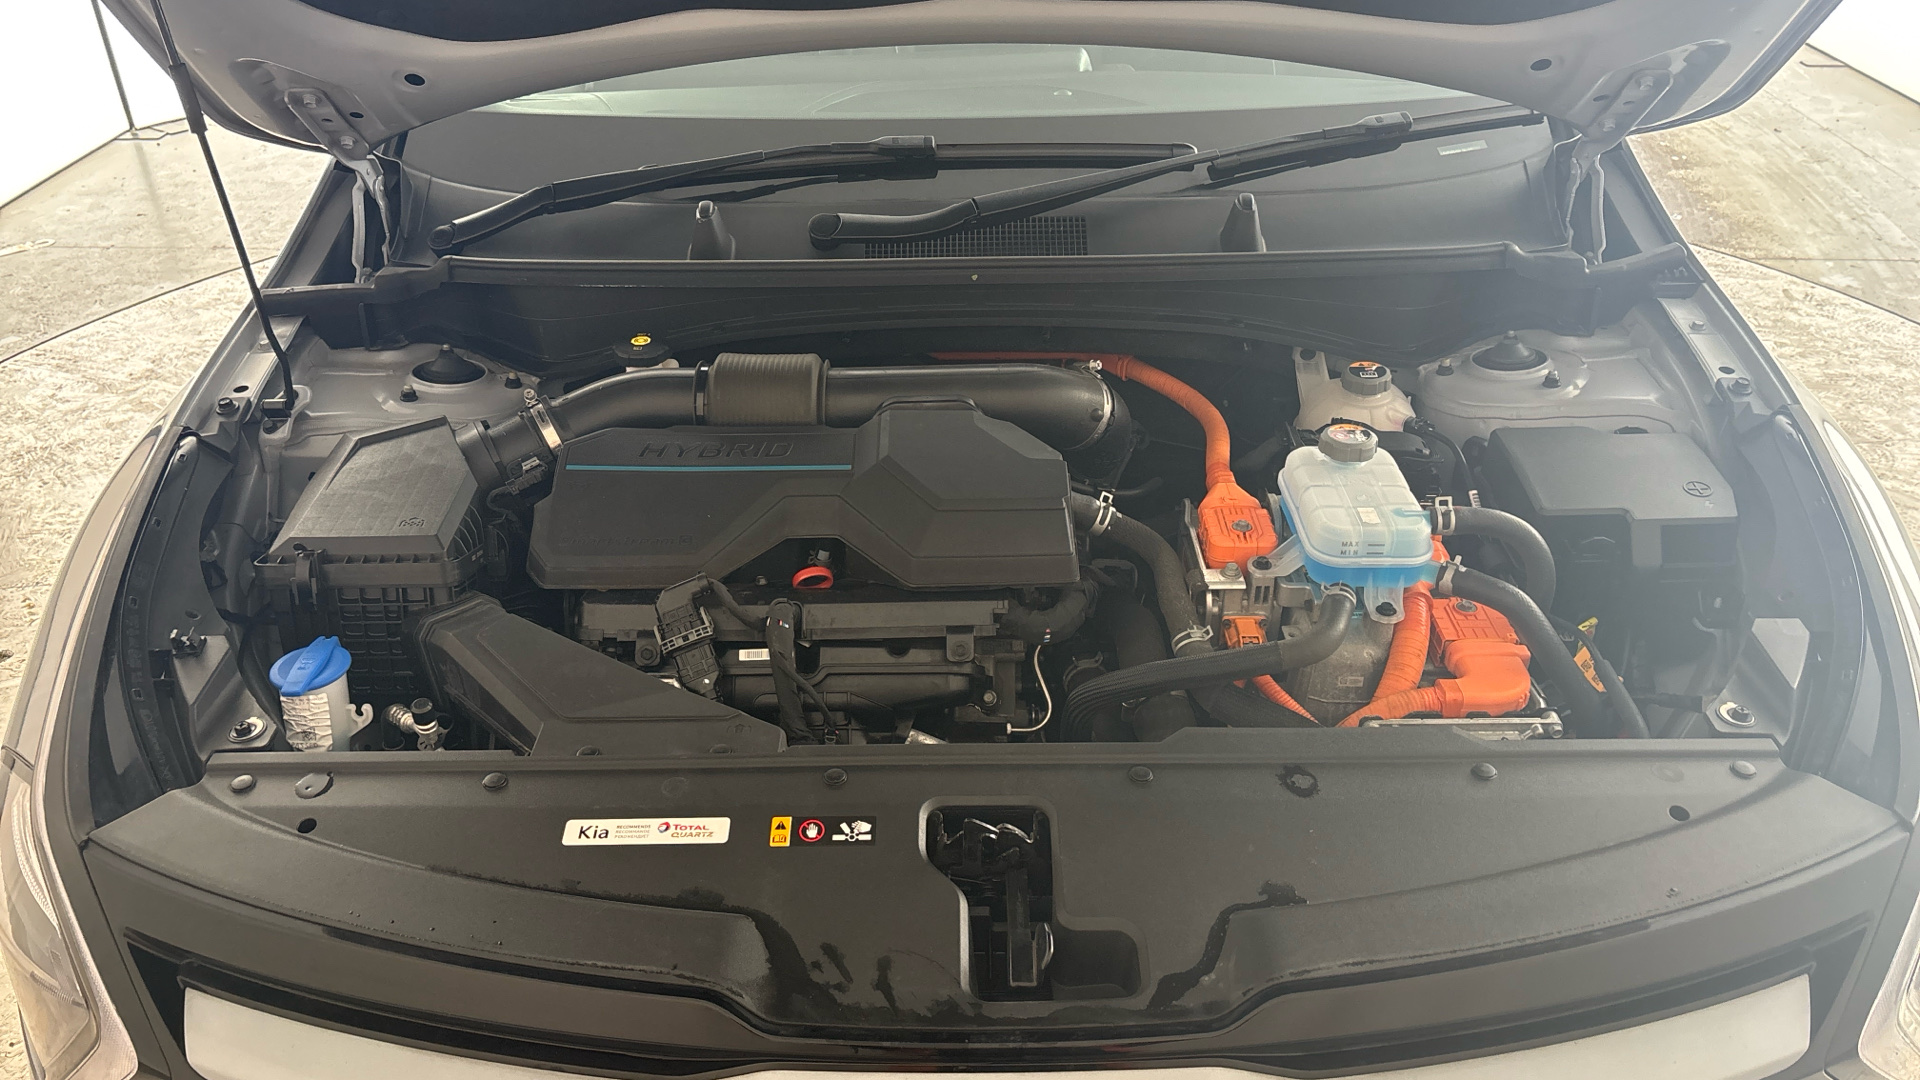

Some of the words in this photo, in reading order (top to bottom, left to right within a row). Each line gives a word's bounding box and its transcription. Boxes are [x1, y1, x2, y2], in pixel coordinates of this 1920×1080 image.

[638, 442, 795, 459] HYBRID
[577, 825, 609, 839] Kia
[672, 823, 710, 831] TOTAL
